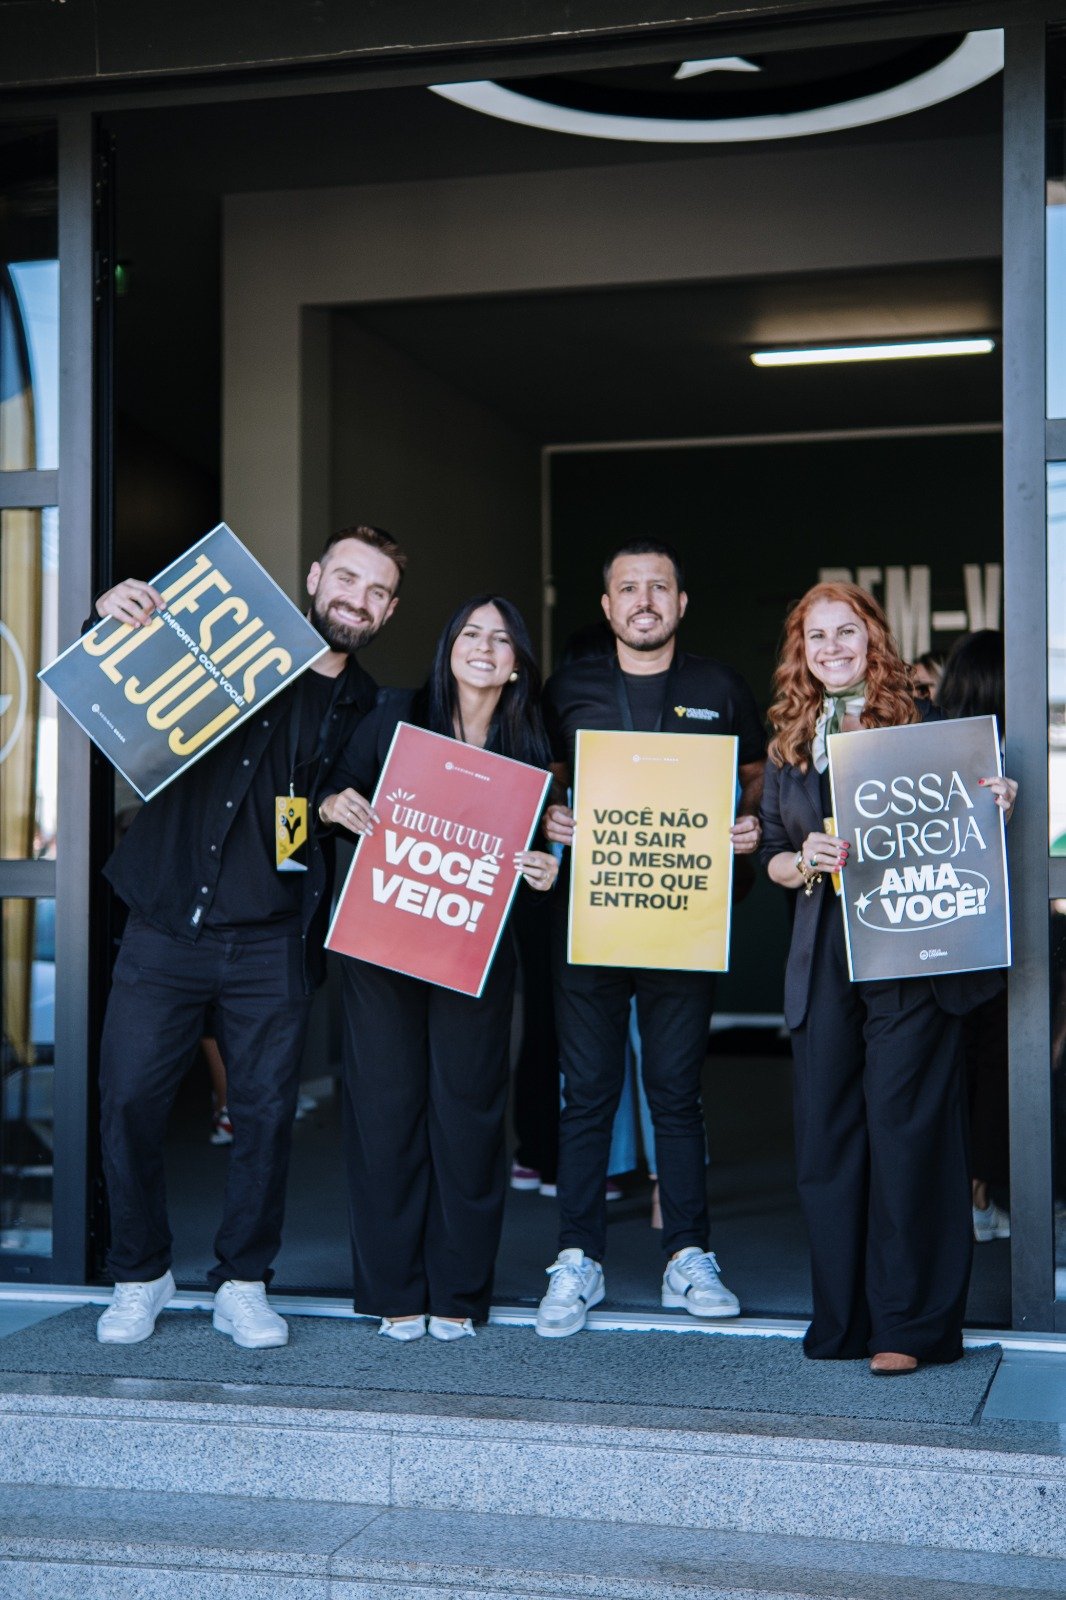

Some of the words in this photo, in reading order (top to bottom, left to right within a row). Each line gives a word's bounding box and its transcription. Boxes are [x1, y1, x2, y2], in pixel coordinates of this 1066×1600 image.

[163, 612, 200, 656] IMPORTA
[199, 654, 220, 678] COM
[854, 771, 974, 819] ESSA
[594, 807, 653, 826] VOCÊ
[660, 808, 708, 828] NÃO
[593, 830, 627, 845] VAI
[635, 831, 686, 848] SAIR
[854, 816, 987, 863] IGREJA
[385, 829, 500, 896] VOCÊ
[591, 851, 622, 866] DO
[629, 852, 712, 870] MESMO
[590, 871, 654, 888] JEITO
[660, 875, 708, 890] QUE
[880, 863, 960, 895] AMA
[372, 868, 484, 933] VEIO!
[590, 892, 688, 911] ENTROU!
[880, 883, 987, 924] VOCÊ!
